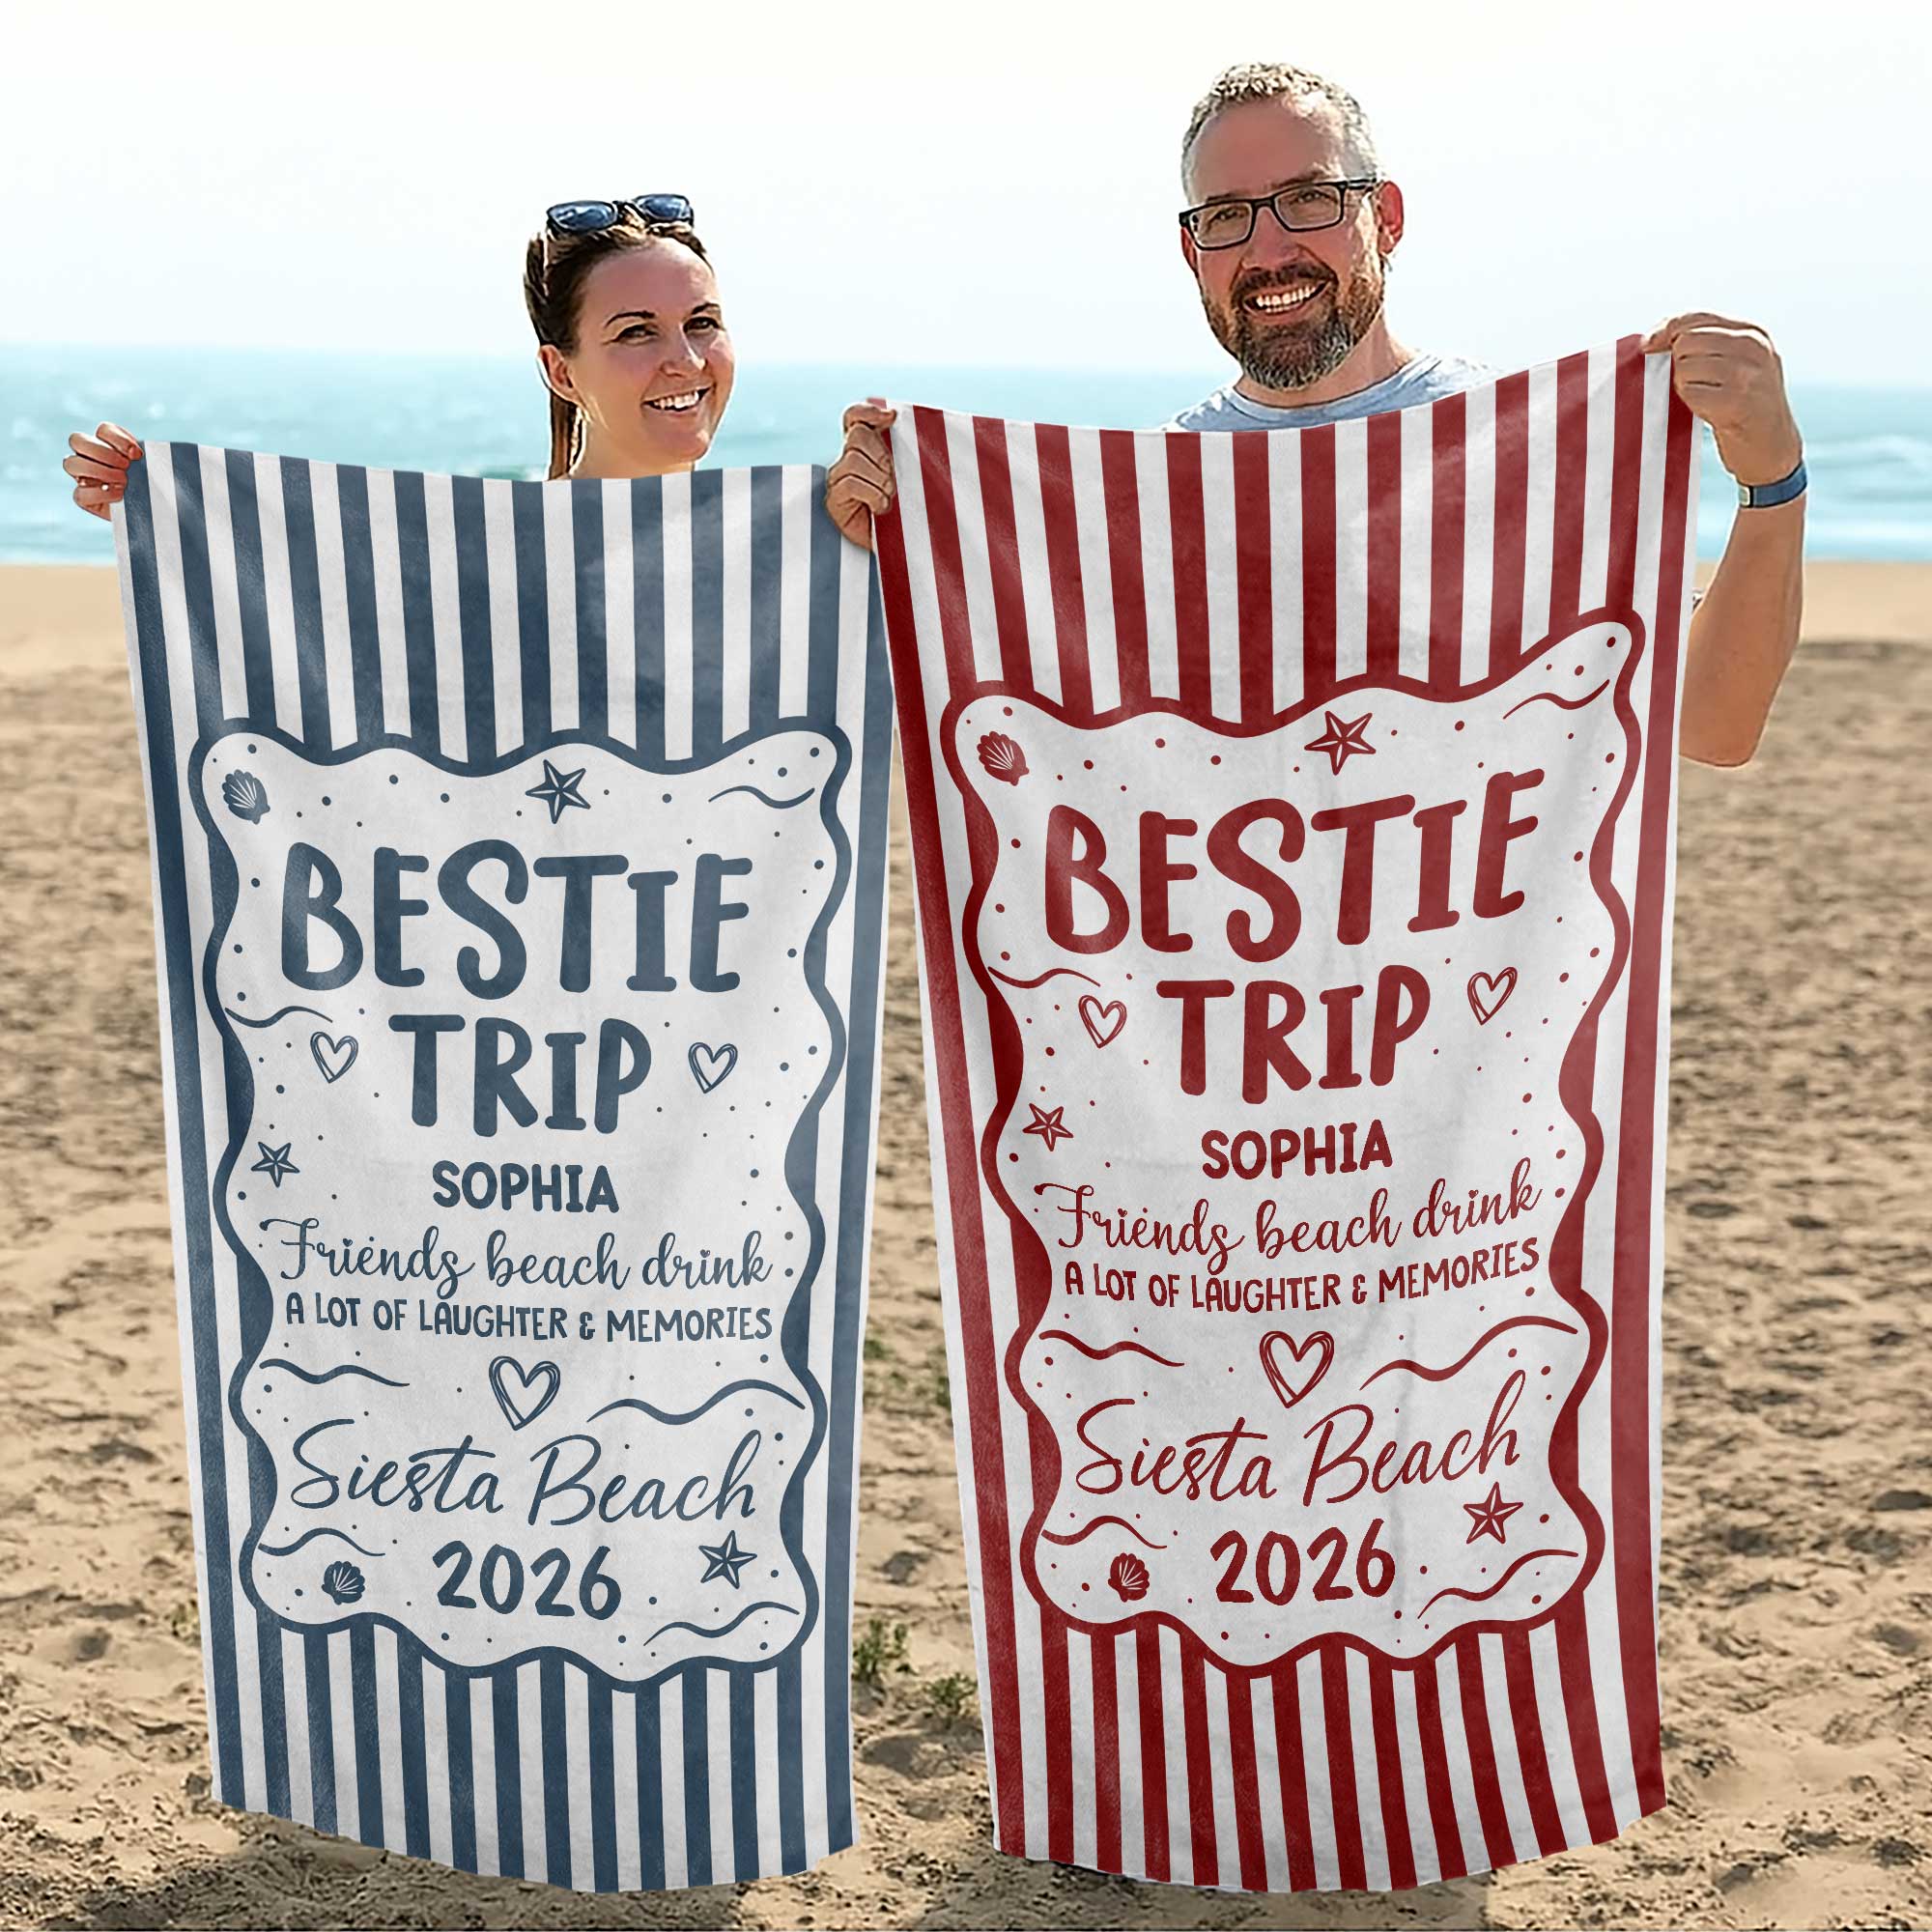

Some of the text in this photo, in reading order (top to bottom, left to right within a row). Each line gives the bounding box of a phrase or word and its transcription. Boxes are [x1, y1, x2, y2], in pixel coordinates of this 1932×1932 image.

[1045, 769, 1545, 962] BESTIE
[281, 839, 753, 1000] BESTIE
[388, 1014, 651, 1137] TRIP
[1156, 965, 1430, 1104] TRIP
[433, 1160, 619, 1213] SOPHIA
[1202, 1120, 1393, 1179] SOPHIA
[259, 1218, 773, 1299] Friends beach drink
[1034, 1157, 1543, 1275] Friends beach drink
[286, 1293, 772, 1342] A LOT OF LAUGHTER & MEMORIES
[1065, 1237, 1539, 1313] A LOT OF LAUGHTER & MEMORIES
[291, 1419, 761, 1525] Siesta Beach
[1076, 1370, 1525, 1507] Siesta Beach
[433, 1541, 621, 1620] 2026
[1210, 1519, 1395, 1605] 2026
